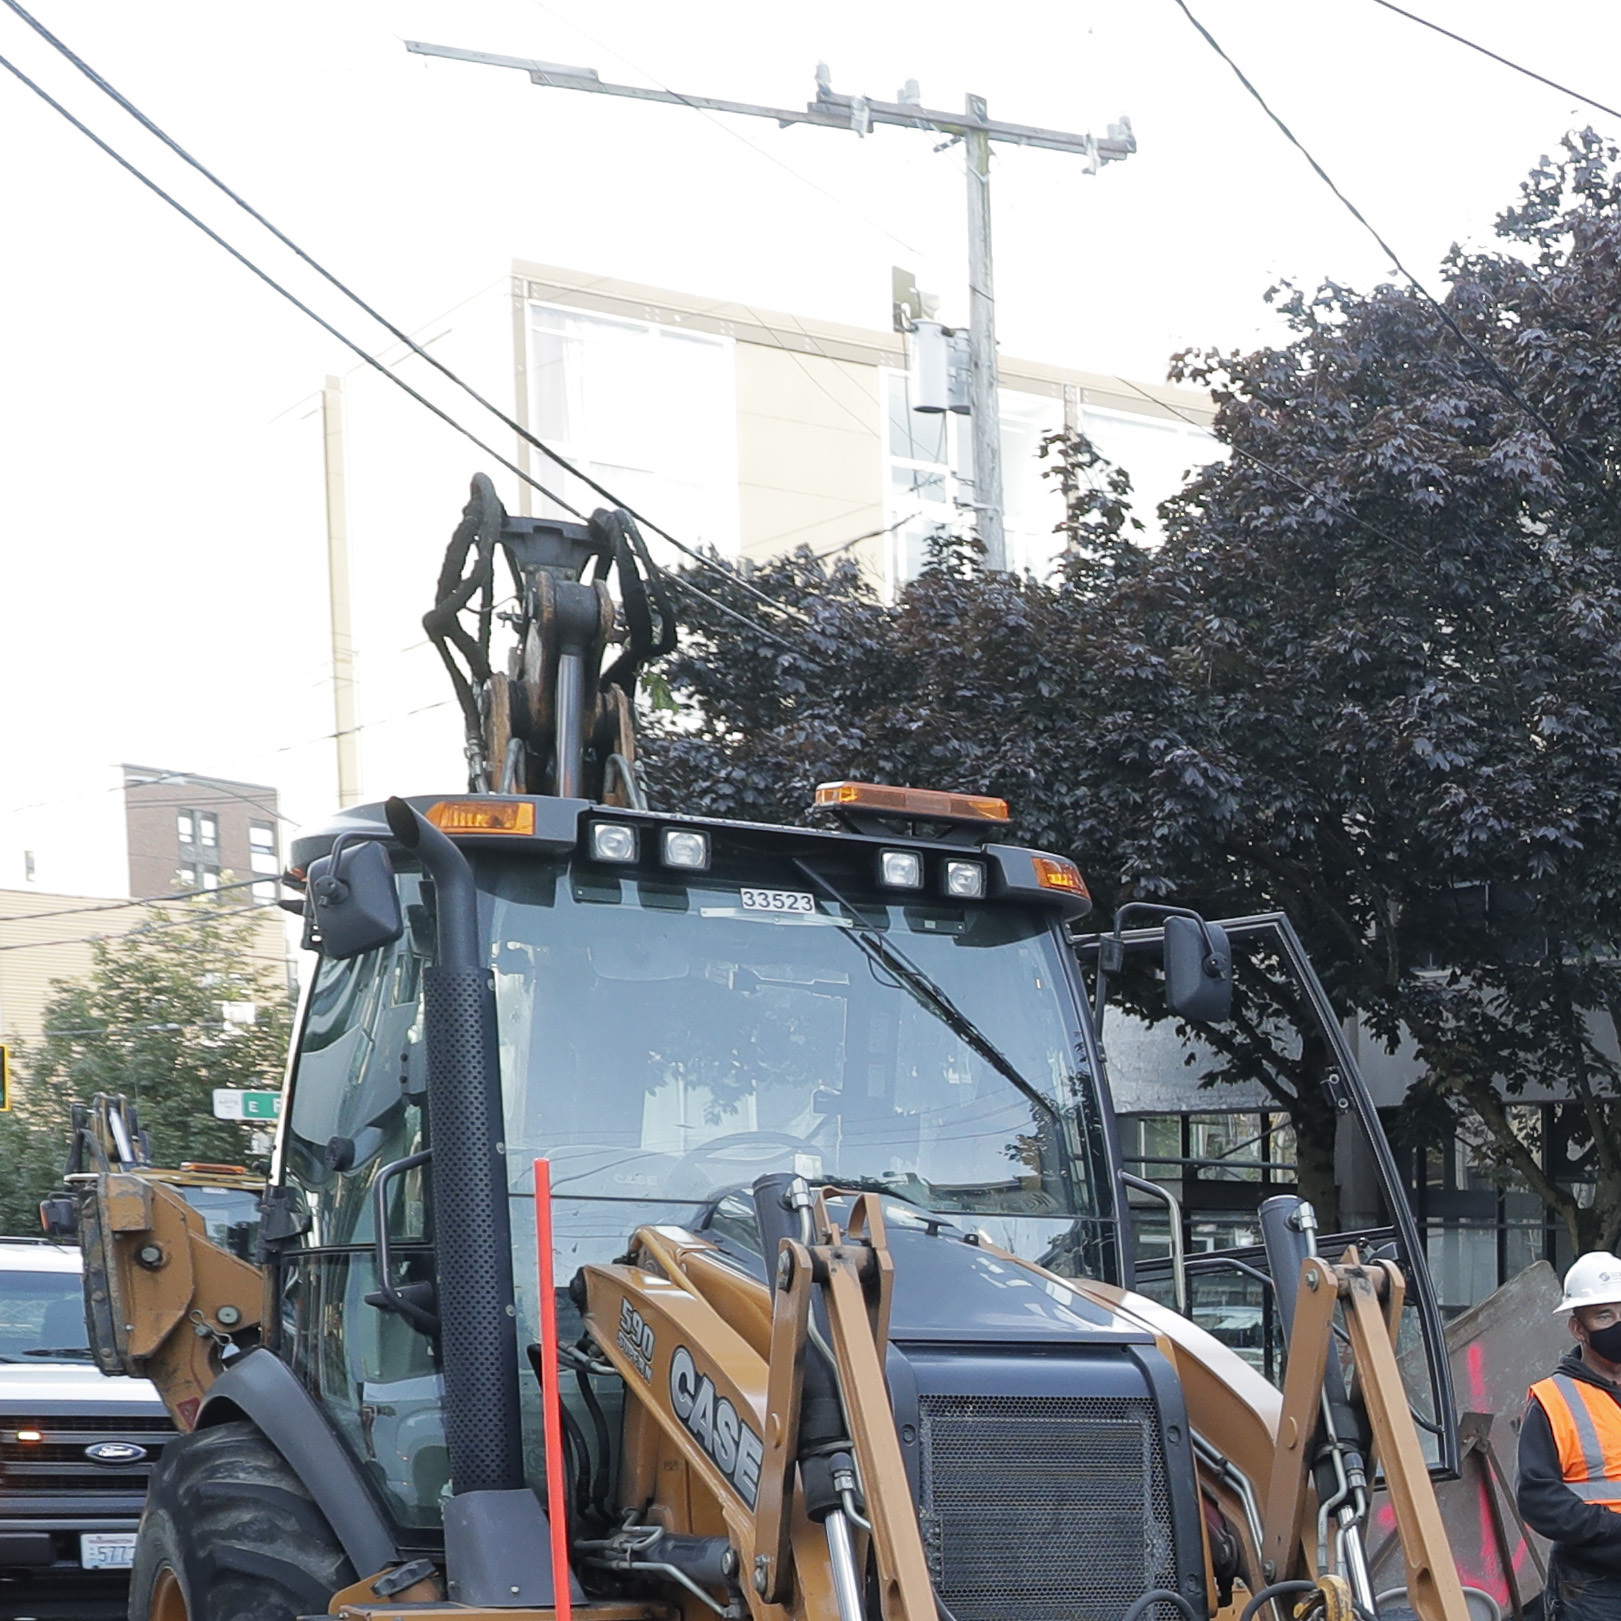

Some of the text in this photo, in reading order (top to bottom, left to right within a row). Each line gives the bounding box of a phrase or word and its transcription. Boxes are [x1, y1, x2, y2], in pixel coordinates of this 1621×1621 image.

[743, 891, 813, 911] 33523
[619, 1295, 655, 1363] 590
[671, 1345, 765, 1512] CASE
